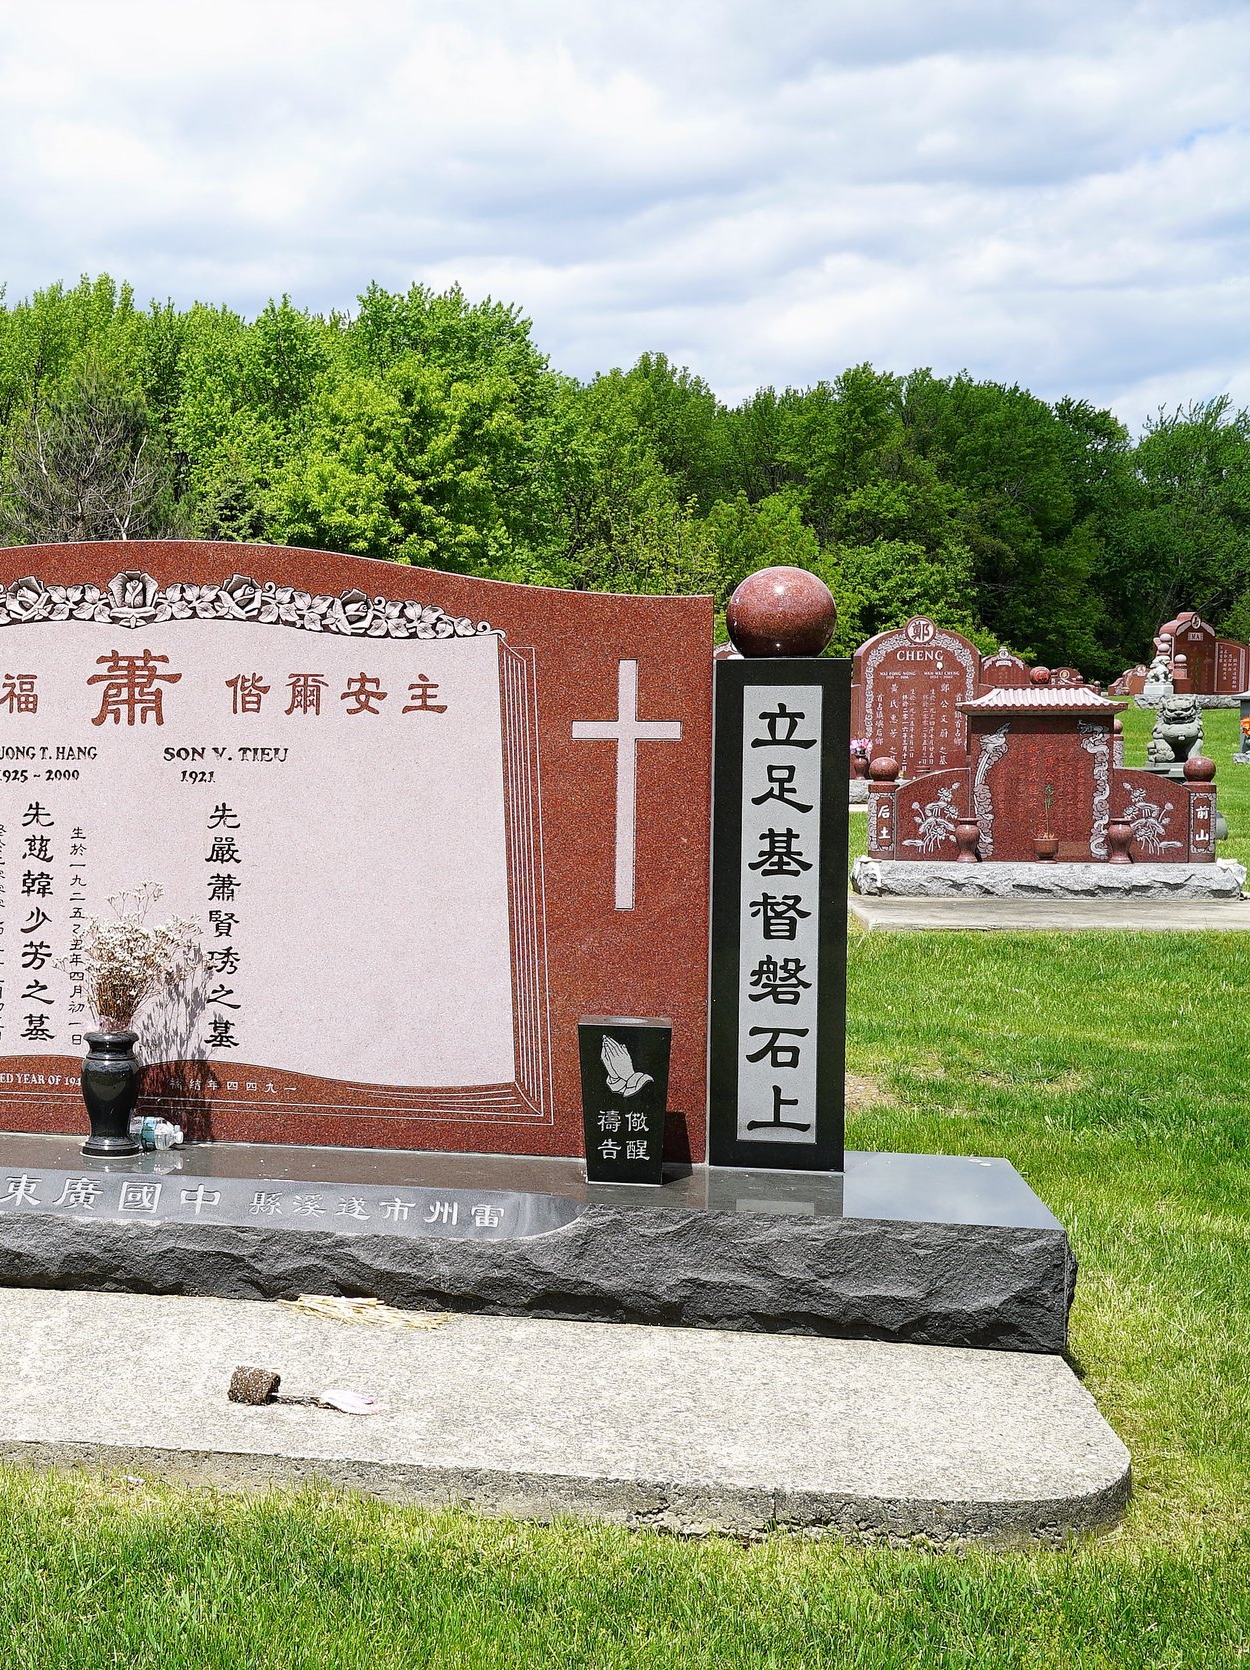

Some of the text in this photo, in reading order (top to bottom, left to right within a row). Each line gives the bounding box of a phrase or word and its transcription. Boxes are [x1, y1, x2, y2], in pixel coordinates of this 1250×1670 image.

[911, 621, 930, 641] 鄭
[897, 650, 943, 661] CHENG
[86, 649, 182, 726] 蕭
[39, 746, 52, 760] T.
[55, 746, 98, 760] HANG
[163, 747, 289, 762] SON V. TIEU
[45, 769, 80, 782] 2000
[180, 769, 216, 784] 1921
[877, 804, 891, 839] 后土
[1195, 805, 1210, 841] 前山
[745, 702, 818, 1131] 立足基督磐石上
[16, 1073, 45, 1085] YEAR
[47, 1075, 62, 1086] OF
[64, 1076, 82, 1087] 194
[597, 1110, 622, 1160] 禱告
